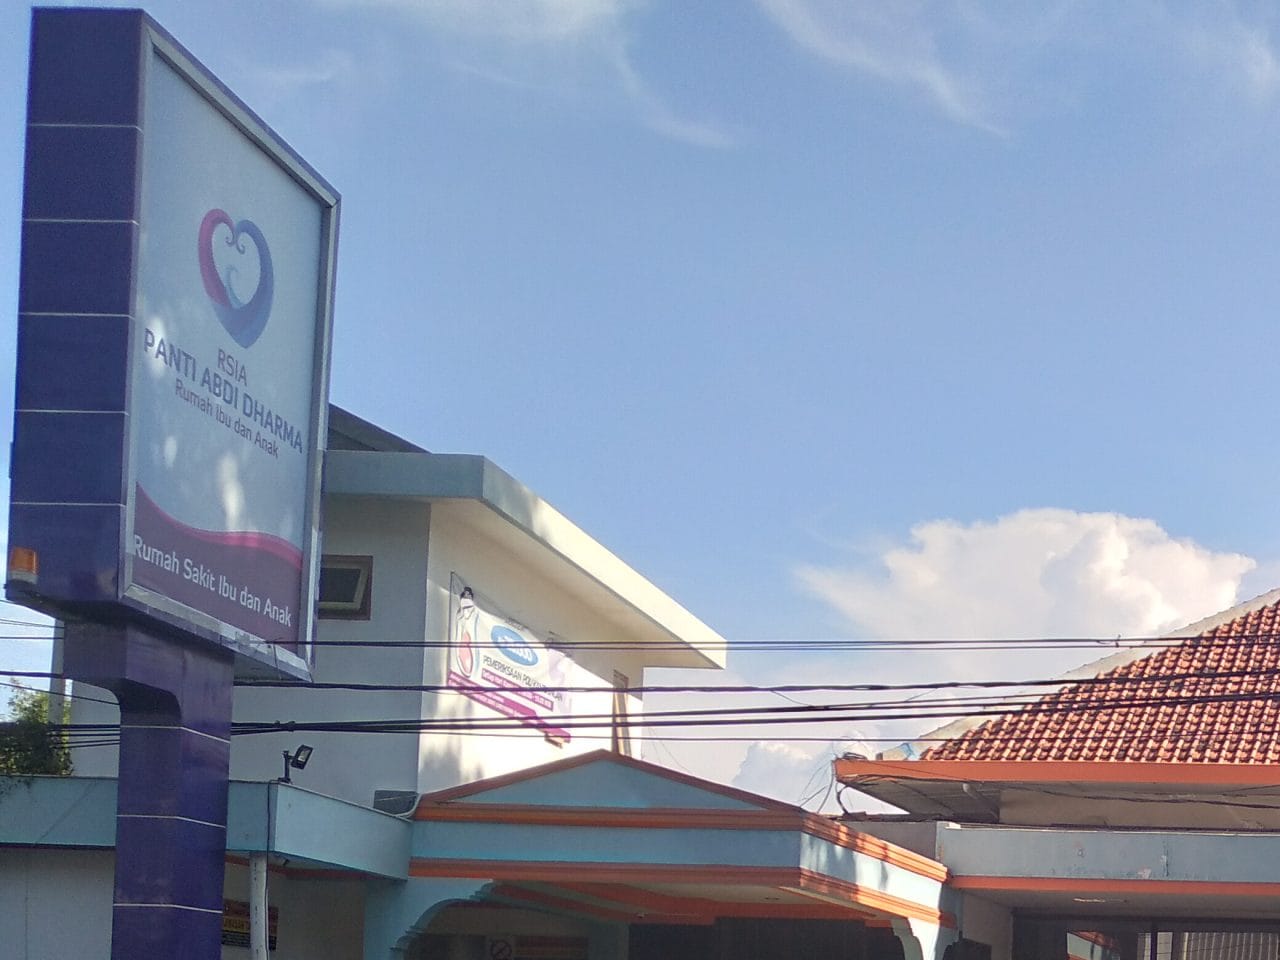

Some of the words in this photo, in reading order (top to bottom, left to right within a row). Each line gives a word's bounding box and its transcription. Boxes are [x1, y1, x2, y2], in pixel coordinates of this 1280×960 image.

[143, 328, 197, 382] PANTI
[200, 364, 240, 412] ABDI
[243, 392, 303, 453] DHARMA
[217, 348, 247, 387] RSIA
[174, 378, 214, 419] Rumah
[215, 401, 232, 431] Ibu
[234, 412, 253, 443] dan
[254, 424, 279, 458] Anak
[133, 534, 180, 575] Rumah
[183, 558, 216, 591] Sakit
[218, 574, 237, 604] Ibu
[239, 582, 262, 612] dan
[264, 596, 292, 627] Anak
